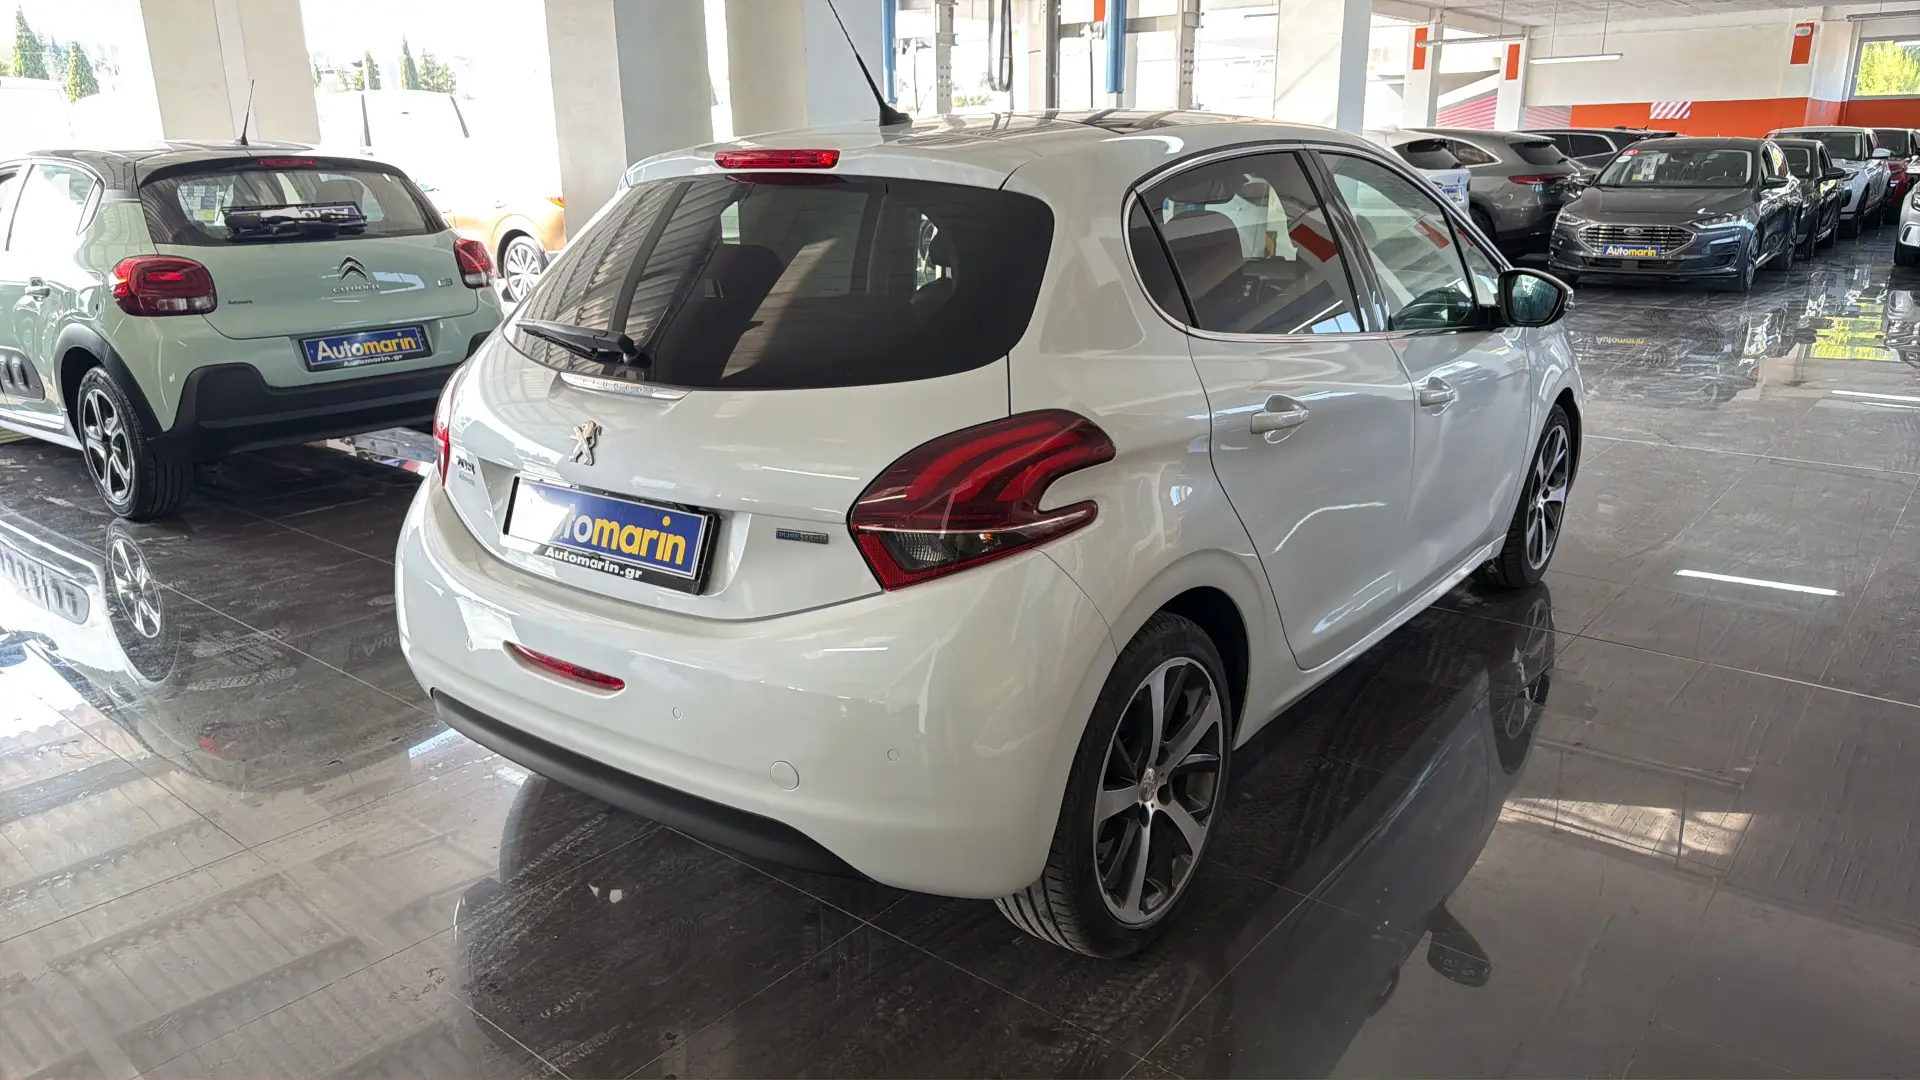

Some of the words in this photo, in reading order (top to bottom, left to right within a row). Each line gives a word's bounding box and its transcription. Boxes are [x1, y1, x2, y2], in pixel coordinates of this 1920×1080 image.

[1606, 245, 1656, 257] Automarin
[317, 331, 417, 361] Automarin
[343, 354, 403, 367] Automarin.gr
[540, 500, 686, 566] tomarin
[544, 547, 643, 580] Automarin.gr
